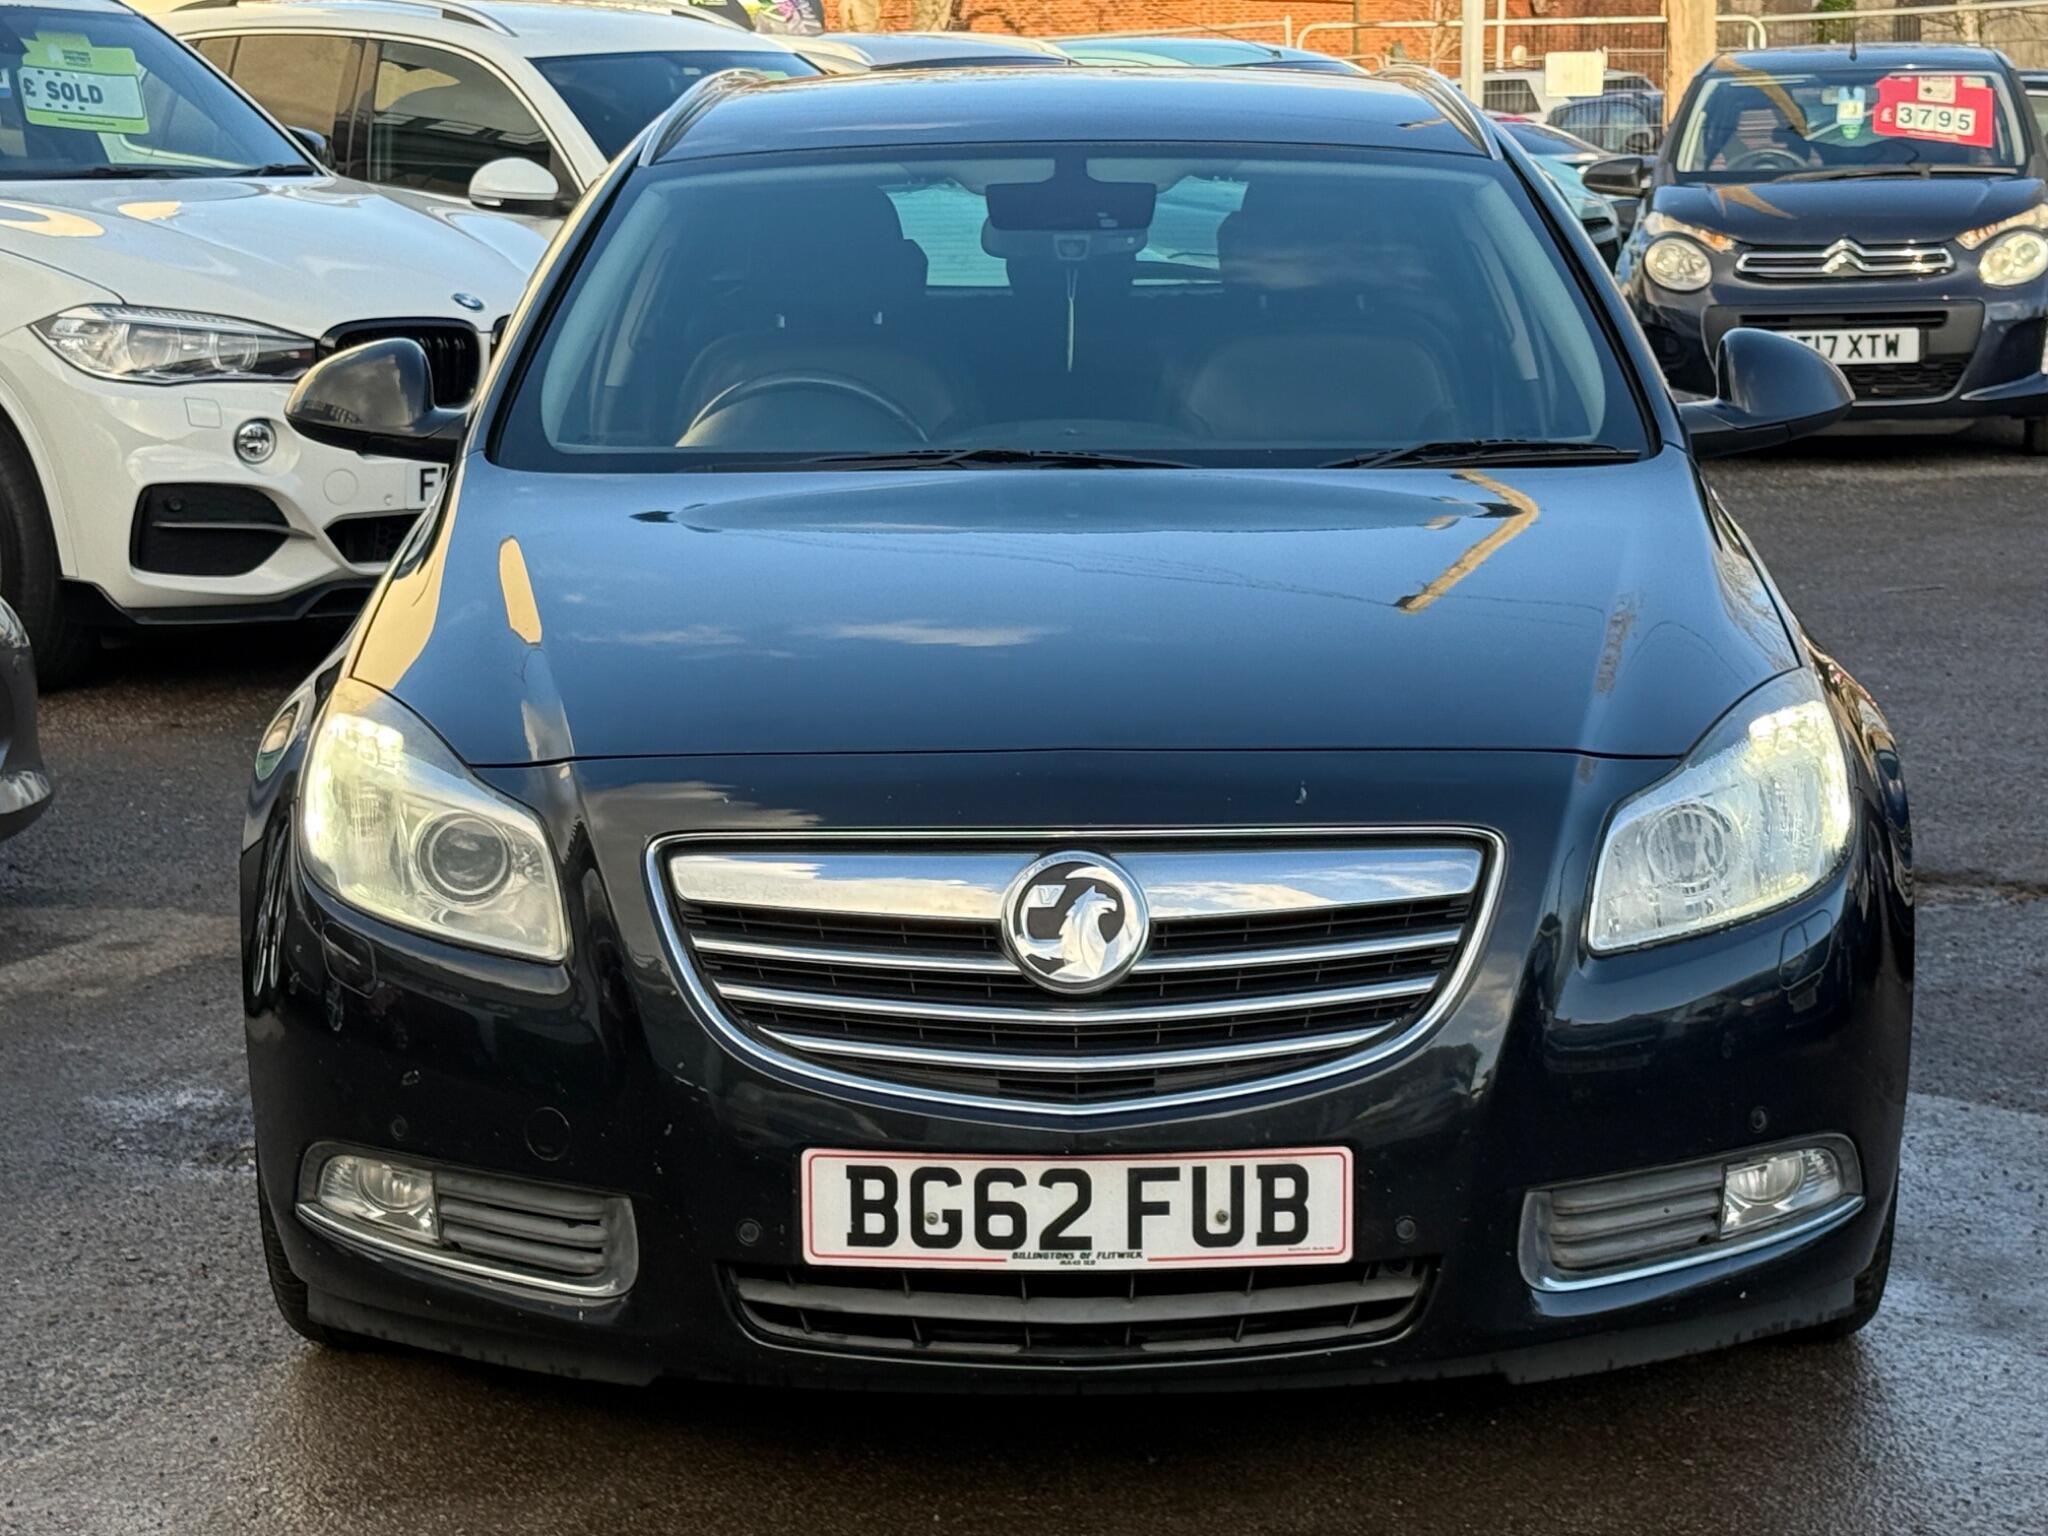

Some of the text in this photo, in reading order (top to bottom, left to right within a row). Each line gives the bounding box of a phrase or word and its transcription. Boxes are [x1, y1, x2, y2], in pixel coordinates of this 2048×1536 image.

[45, 80, 104, 104] SOLD
[1847, 333, 1900, 359] XTW
[845, 1163, 1310, 1251] BG62 FUB
